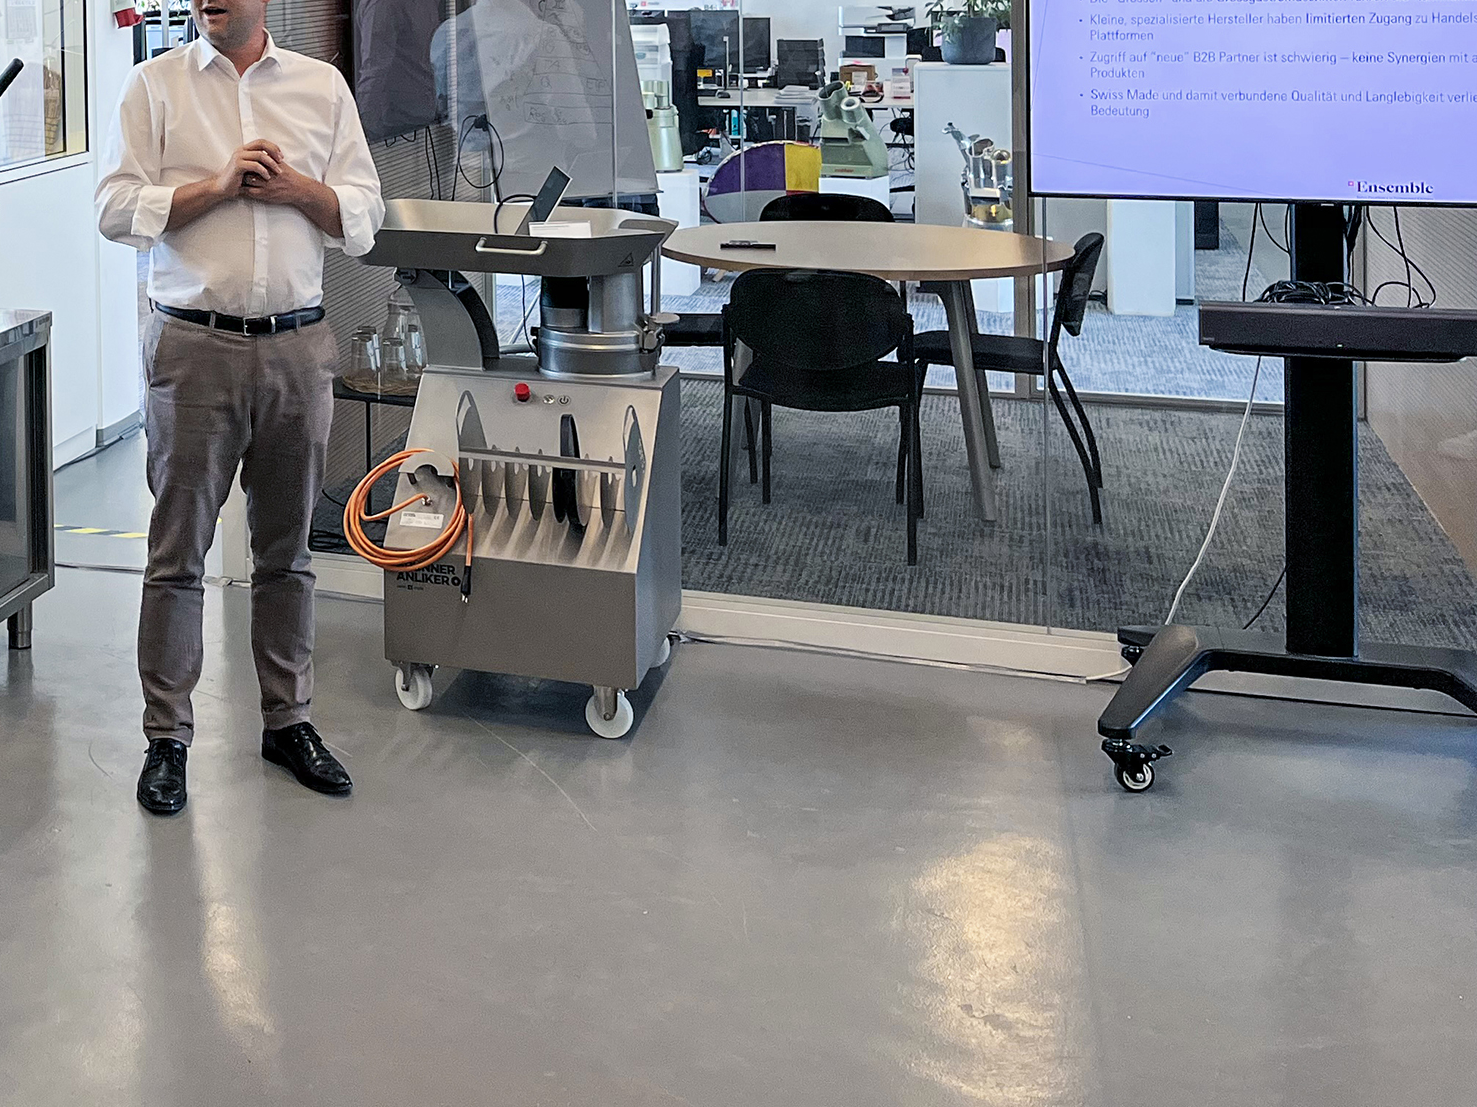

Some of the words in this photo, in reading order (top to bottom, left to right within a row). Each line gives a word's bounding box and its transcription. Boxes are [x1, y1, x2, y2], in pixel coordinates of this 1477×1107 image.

[1089, 13, 1127, 27] Kleine,
[1130, 13, 1205, 28] spezialisierte
[1207, 12, 1264, 25] Hersteller
[1266, 12, 1302, 25] haben
[1305, 12, 1366, 24] limitierten
[1368, 11, 1412, 27] Zugang
[1414, 14, 1428, 24] zu
[1089, 29, 1154, 41] Plattformen
[1089, 50, 1127, 65] Zugriff
[1129, 50, 1148, 63] auf
[1193, 50, 1216, 63] B2B
[1219, 50, 1260, 63] Partner
[1263, 51, 1278, 63] ist
[1280, 50, 1337, 66] schwierig
[1352, 51, 1384, 63] keine
[1387, 51, 1446, 66] Synergien
[1449, 51, 1469, 64] mit
[1090, 66, 1145, 79] Produkten
[1090, 88, 1124, 100] Swiss
[1126, 88, 1159, 100] Made
[1162, 88, 1183, 101] und
[1185, 88, 1218, 101] damit
[1220, 89, 1288, 102] verbundene
[1291, 89, 1338, 102] Qualität
[1340, 90, 1362, 102] und
[1365, 90, 1445, 105] Langlebigkeit
[1090, 104, 1150, 119] Bedeutung
[1357, 181, 1434, 194] Ensemble
[397, 572, 450, 586] ANLIKER
